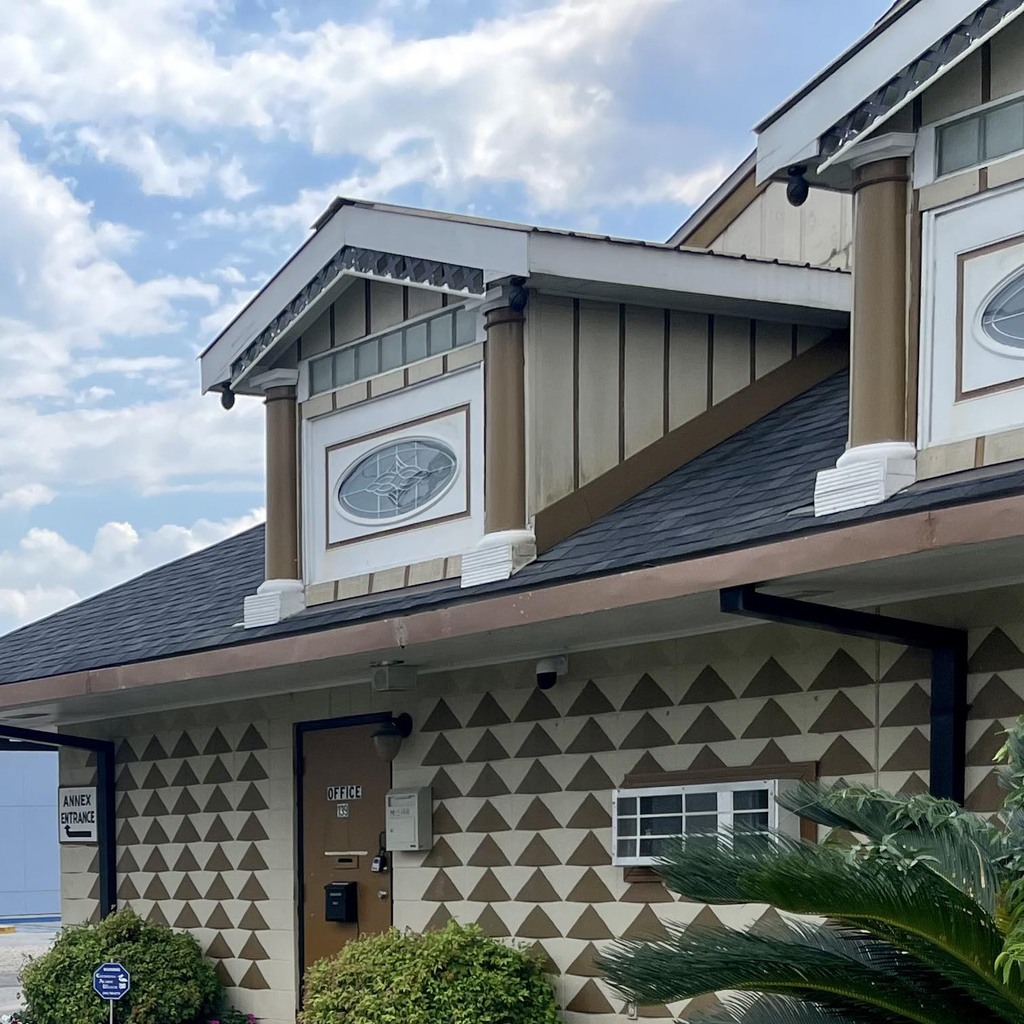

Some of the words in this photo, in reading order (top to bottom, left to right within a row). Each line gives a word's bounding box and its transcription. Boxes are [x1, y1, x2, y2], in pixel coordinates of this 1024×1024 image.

[328, 786, 361, 800] OFFICE
[63, 794, 91, 807] ANNEX
[61, 811, 95, 824] ENTRANCE
